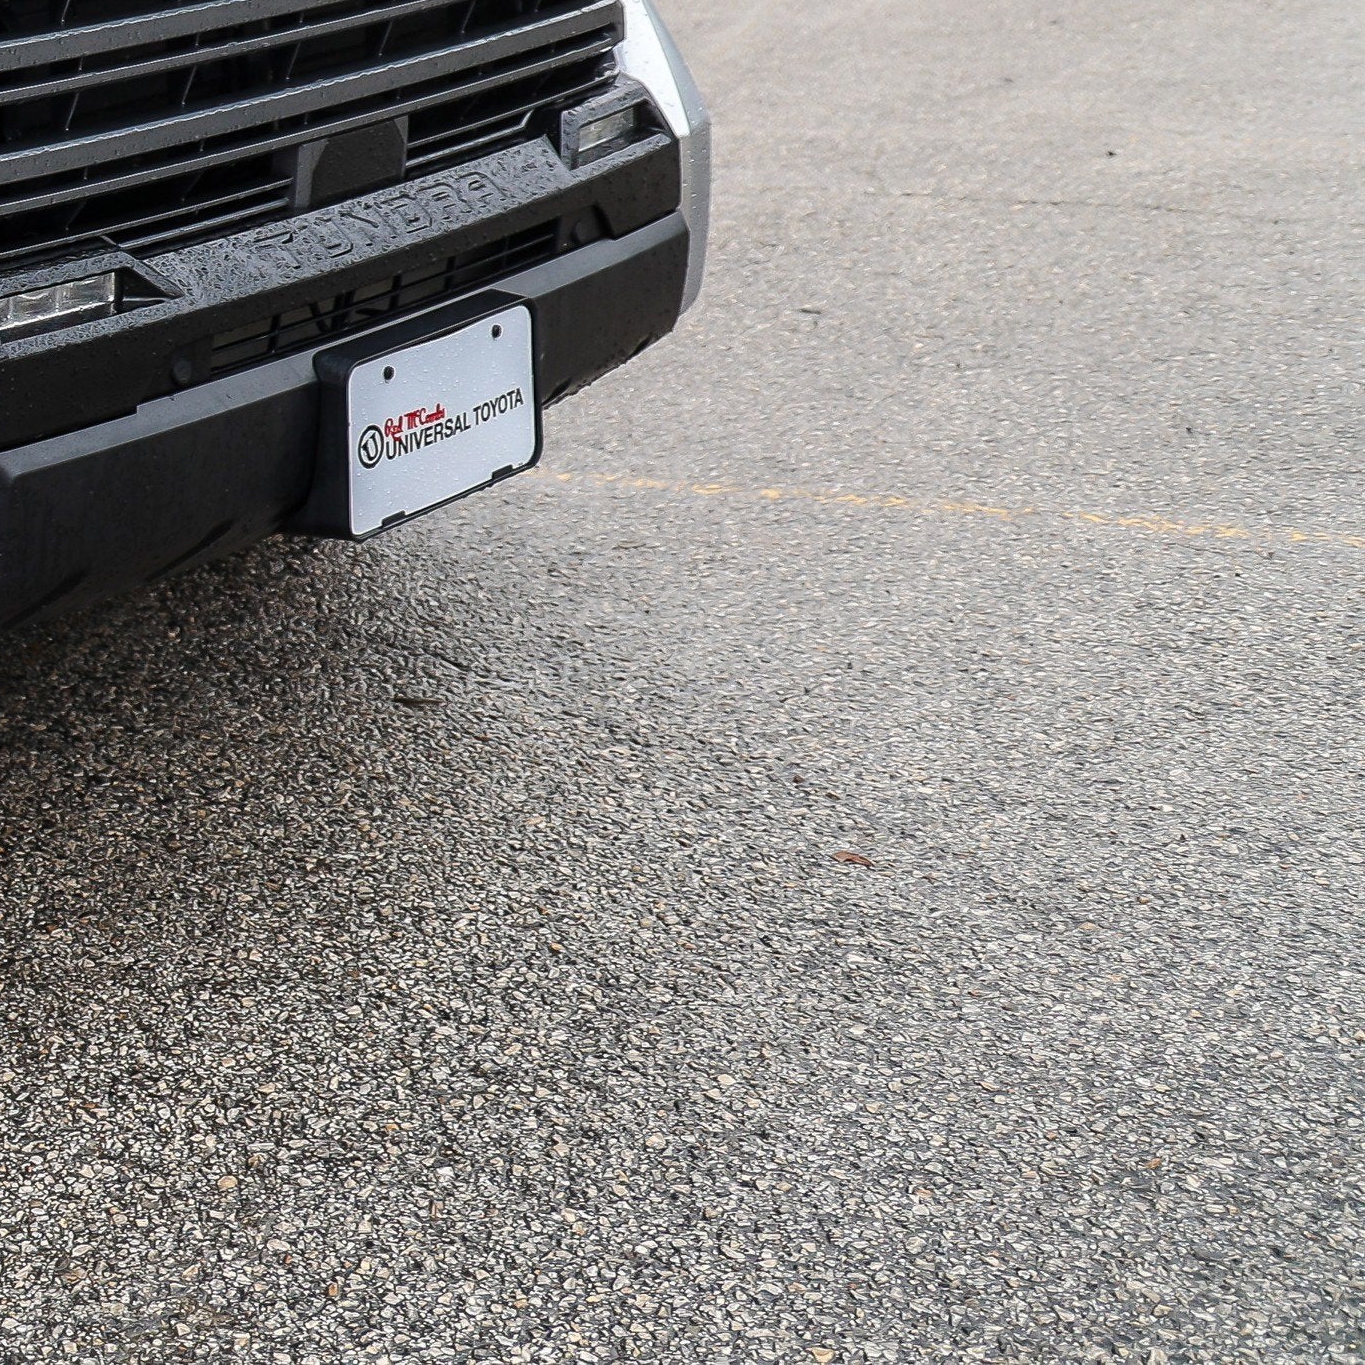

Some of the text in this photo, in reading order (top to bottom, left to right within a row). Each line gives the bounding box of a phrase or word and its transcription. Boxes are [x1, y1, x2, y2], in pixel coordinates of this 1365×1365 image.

[253, 172, 510, 269] TUNDRA
[386, 388, 524, 460] UNIVERSAL TOYOTA
